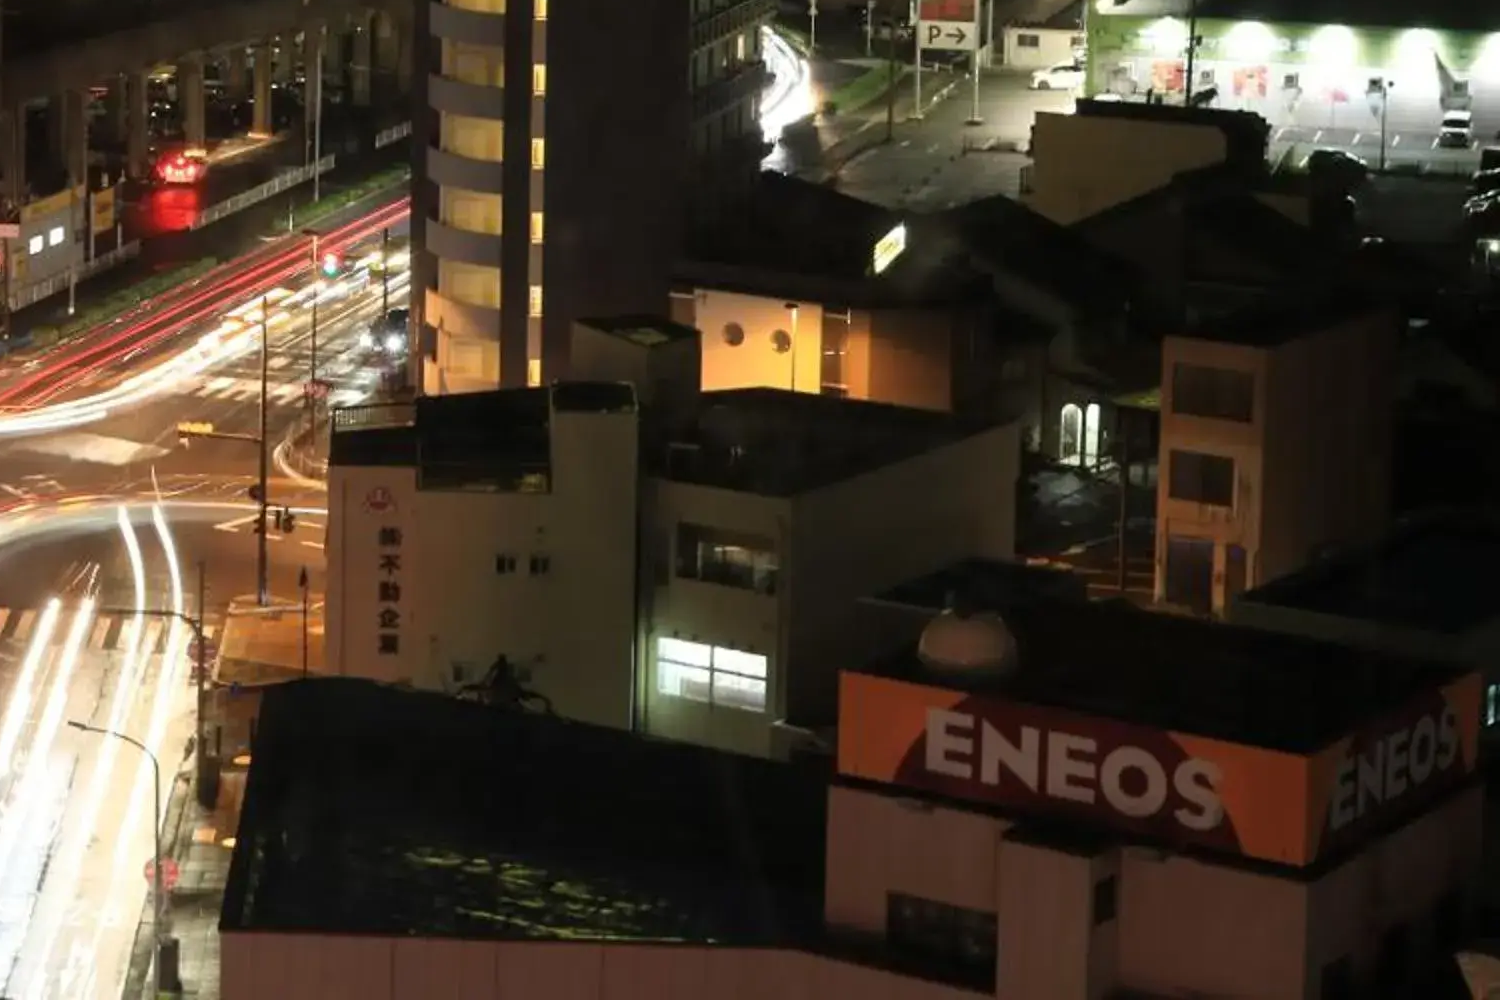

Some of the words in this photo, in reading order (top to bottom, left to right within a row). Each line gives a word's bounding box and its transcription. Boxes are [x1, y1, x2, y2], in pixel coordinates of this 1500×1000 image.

[928, 25, 942, 44] P
[924, 708, 1226, 832] ENEOS
[1329, 705, 1458, 831] ENEOS
